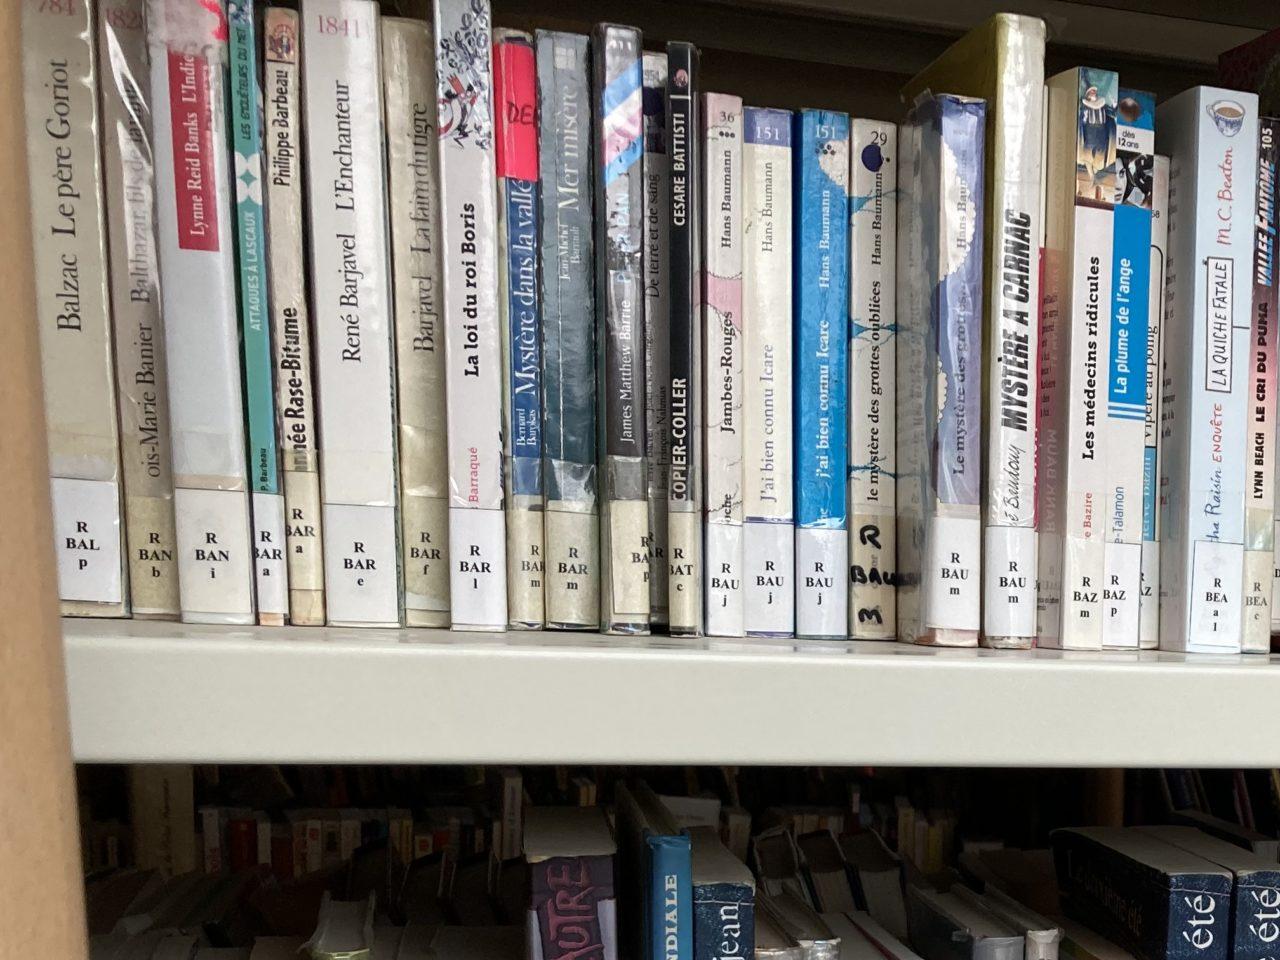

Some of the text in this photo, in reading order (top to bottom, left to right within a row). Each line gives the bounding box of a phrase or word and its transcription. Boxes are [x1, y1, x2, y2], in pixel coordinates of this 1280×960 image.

[673, 113, 685, 226] CESARE BATTISTI
[756, 127, 779, 140] 151
[871, 131, 887, 145] 29
[1262, 127, 1273, 149] 105
[46, 59, 82, 332] Balzac Le père Goriot
[333, 80, 364, 363] René Barjavel L'Enchanteur
[461, 203, 479, 376] La loi du roi Boris
[1003, 211, 1031, 304] CARNAC
[1086, 256, 1100, 335] ridicules
[1114, 258, 1133, 394] La plume de l'ange
[1212, 262, 1228, 386] LA QUICHE FATALE
[720, 311, 735, 434] Jambes-Rouges
[816, 320, 830, 479] j'ai bien connu Icare
[1083, 341, 1097, 432] médecins
[469, 447, 481, 503] Barraqué
[66, 538, 100, 550] BAL
[343, 558, 376, 570] BAR
[712, 578, 740, 589] BAU
[1183, 893, 1216, 949] été
[1249, 888, 1280, 942] été
